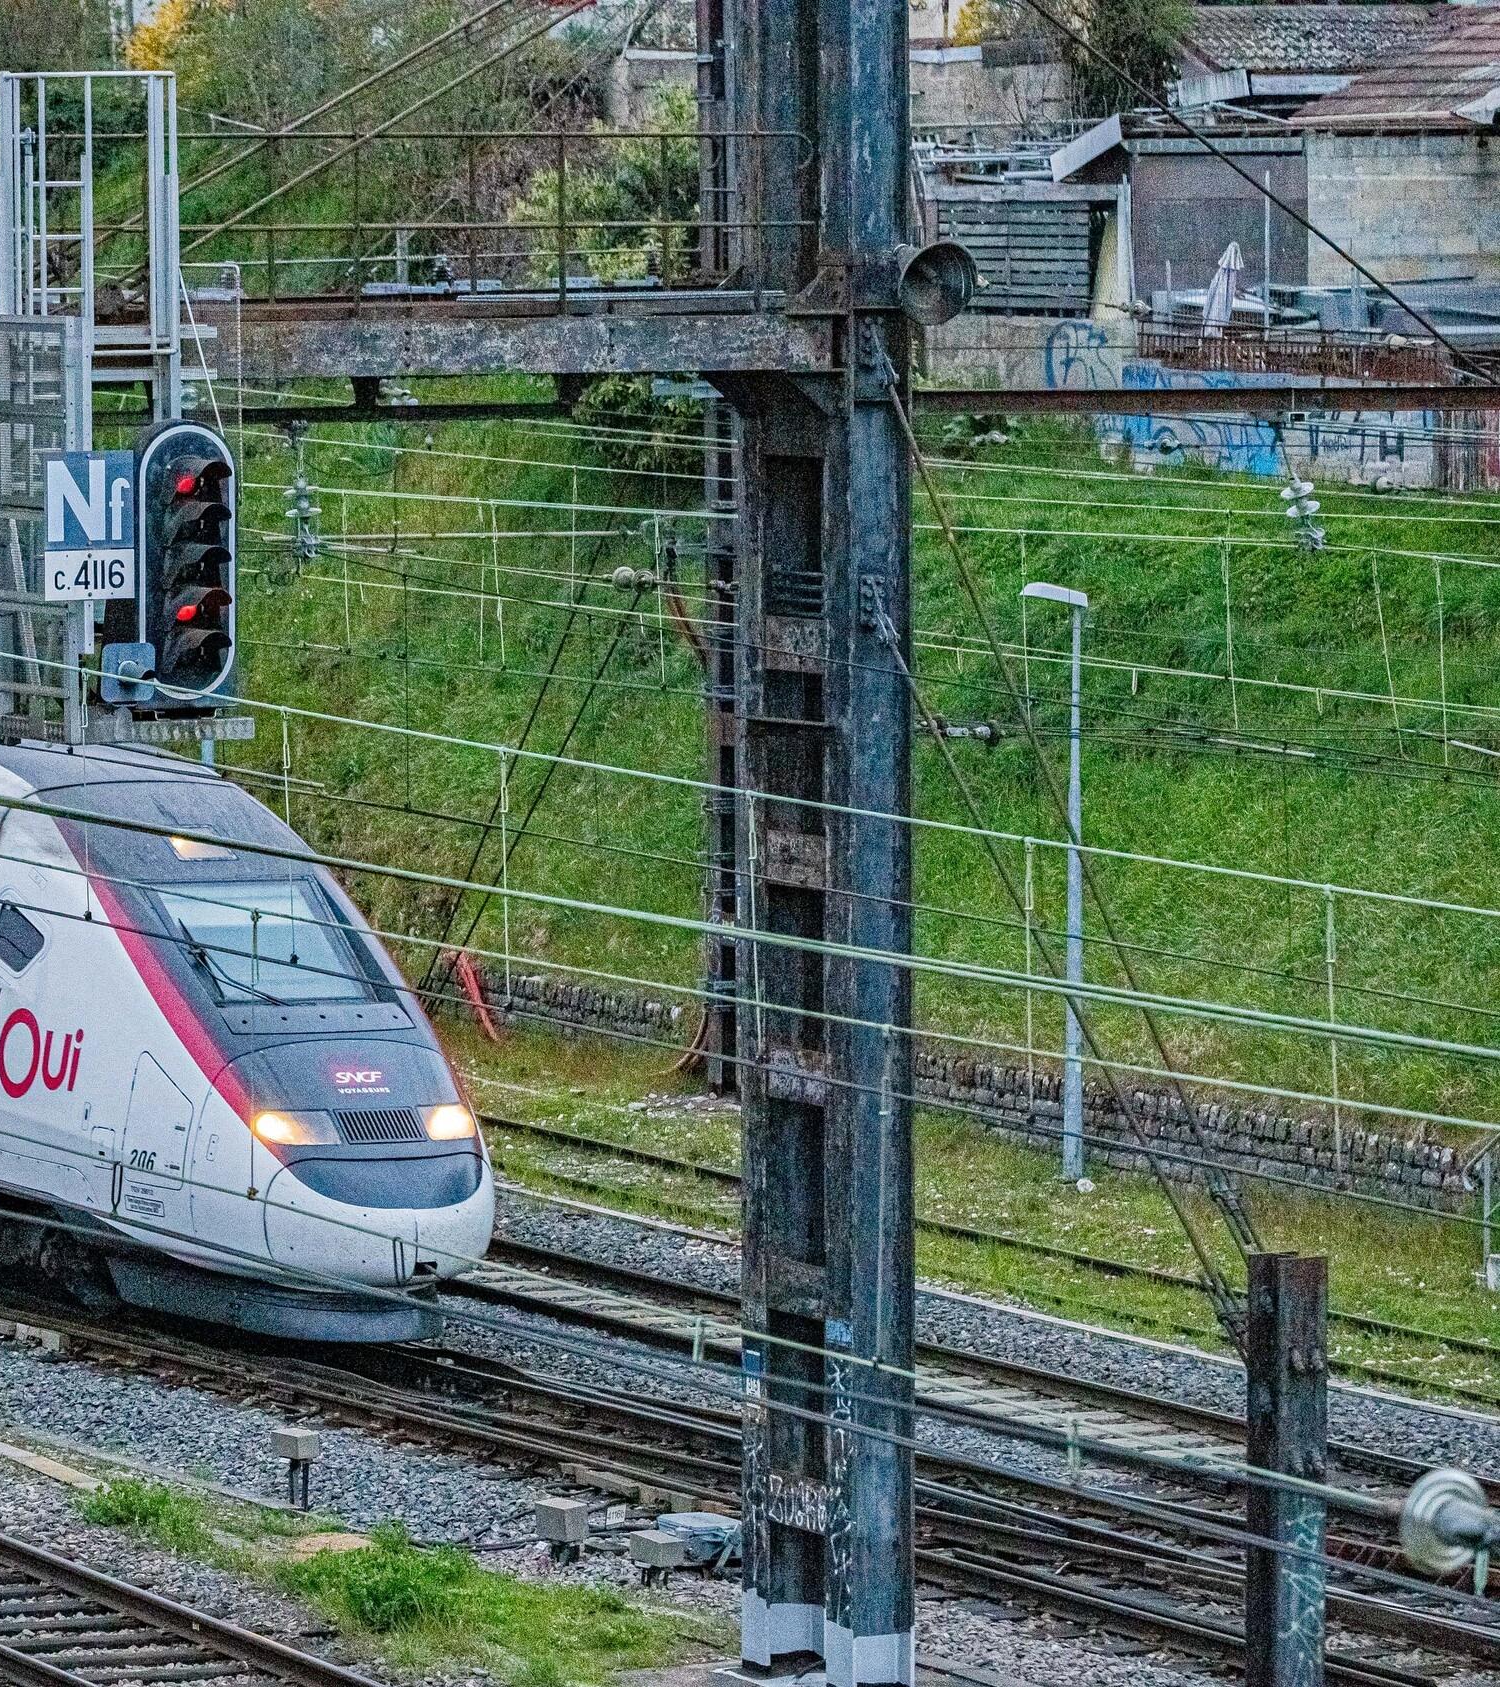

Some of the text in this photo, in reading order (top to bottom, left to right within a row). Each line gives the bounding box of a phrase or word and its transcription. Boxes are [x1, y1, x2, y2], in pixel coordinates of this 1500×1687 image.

[47, 460, 130, 542] Nf
[54, 559, 125, 590] c.4116
[335, 1071, 382, 1083] SNCF
[130, 1149, 156, 1171] 206
